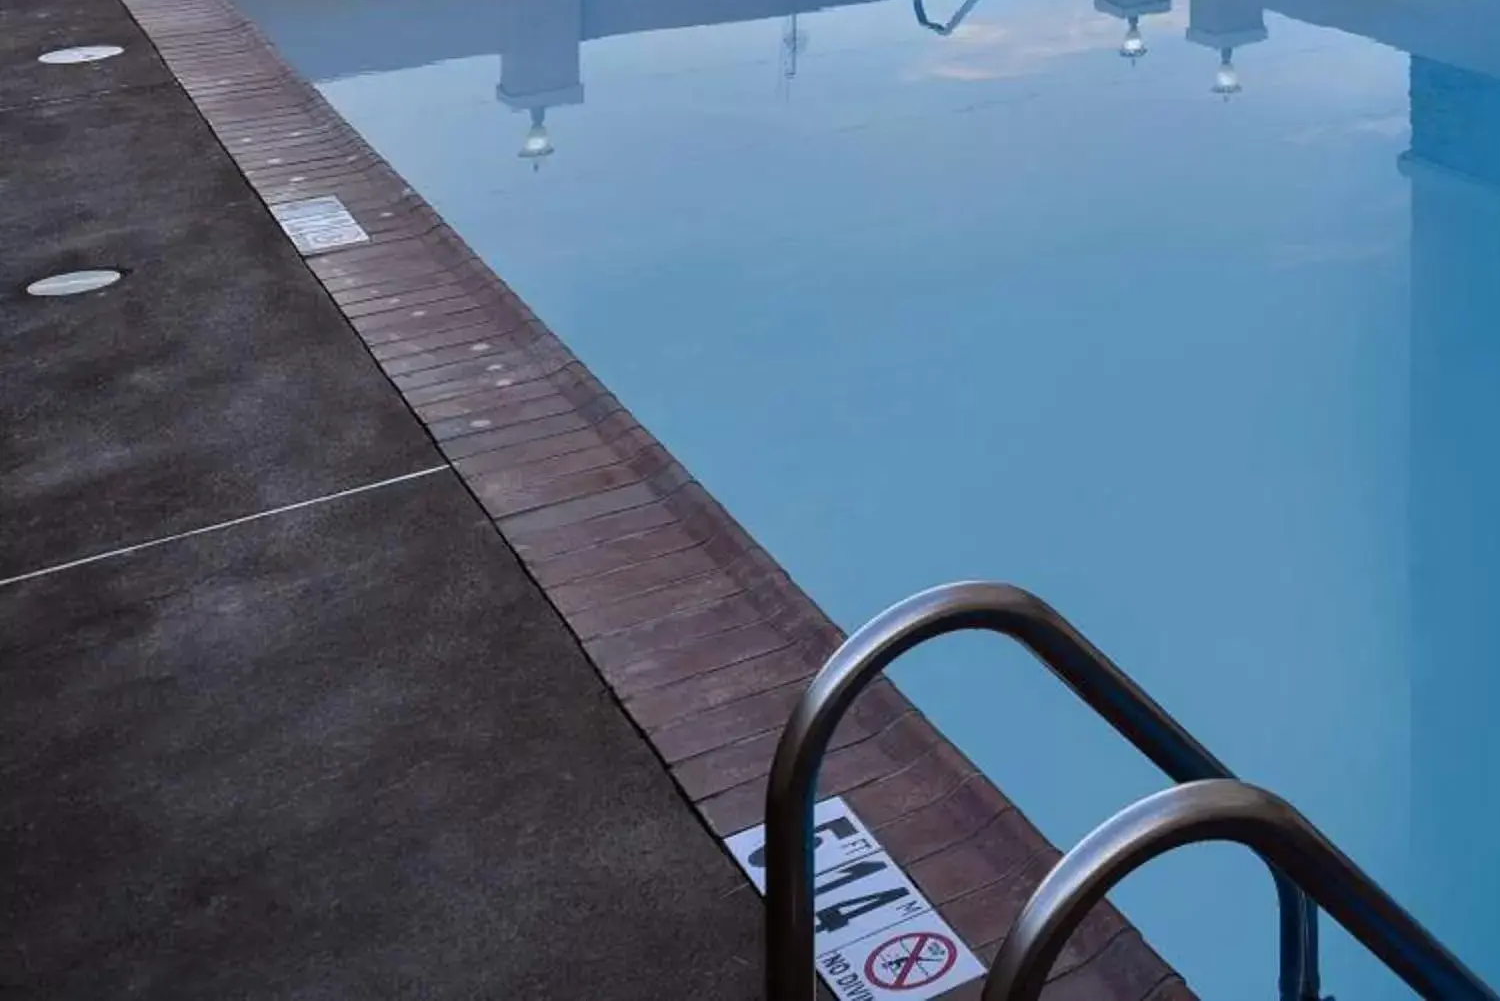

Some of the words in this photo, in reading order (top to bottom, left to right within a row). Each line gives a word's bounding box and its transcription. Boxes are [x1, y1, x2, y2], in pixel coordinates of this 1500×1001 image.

[840, 837, 873, 856] FT
[895, 900, 923, 917] M
[821, 953, 851, 976] NO
